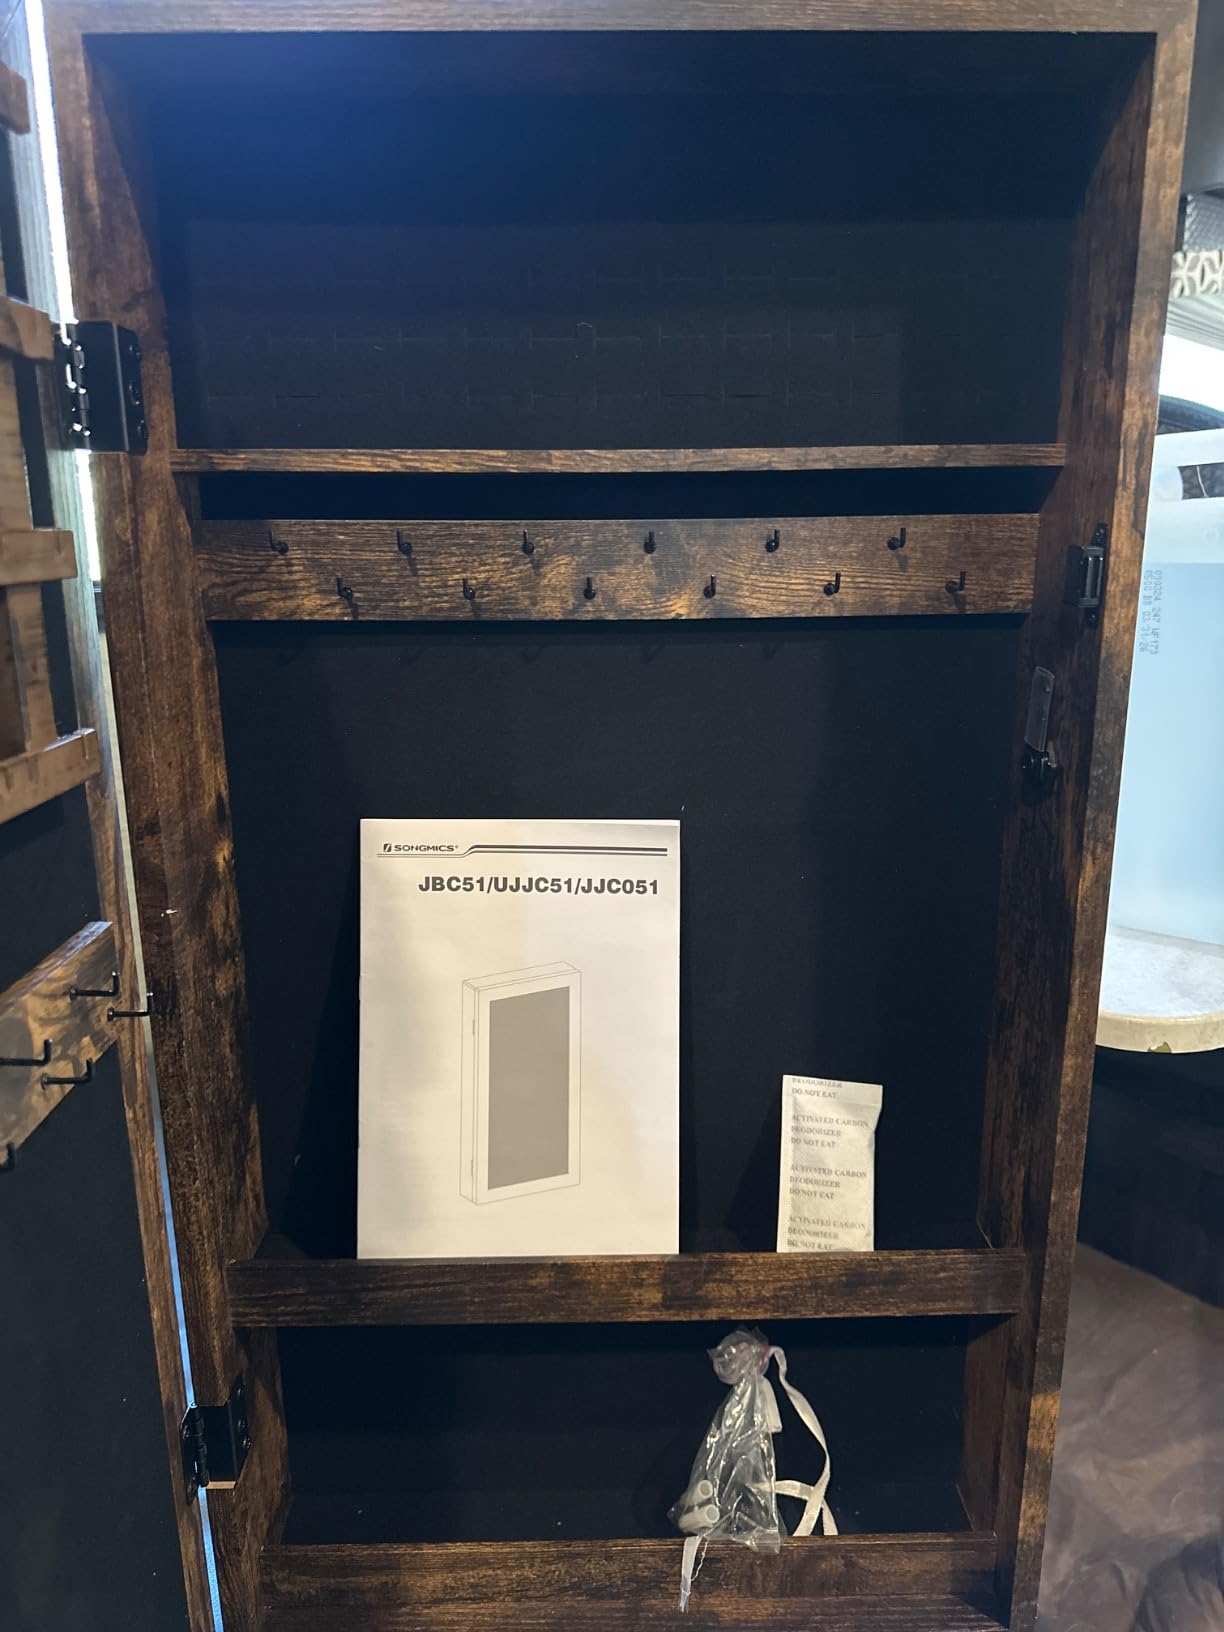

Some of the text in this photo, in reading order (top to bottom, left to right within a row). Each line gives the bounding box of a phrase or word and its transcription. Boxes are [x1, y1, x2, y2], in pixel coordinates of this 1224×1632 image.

[393, 844, 455, 852] SONGMICS
[418, 875, 659, 895] JBC51/UJJC51/JJC051
[804, 1089, 821, 1097] NOT
[792, 1114, 869, 1128] ACTIVATED CARBON
[803, 1138, 820, 1146] NOT
[821, 1140, 836, 1148] EAT
[834, 1169, 867, 1178] CARBON
[800, 1189, 818, 1198] NOT
